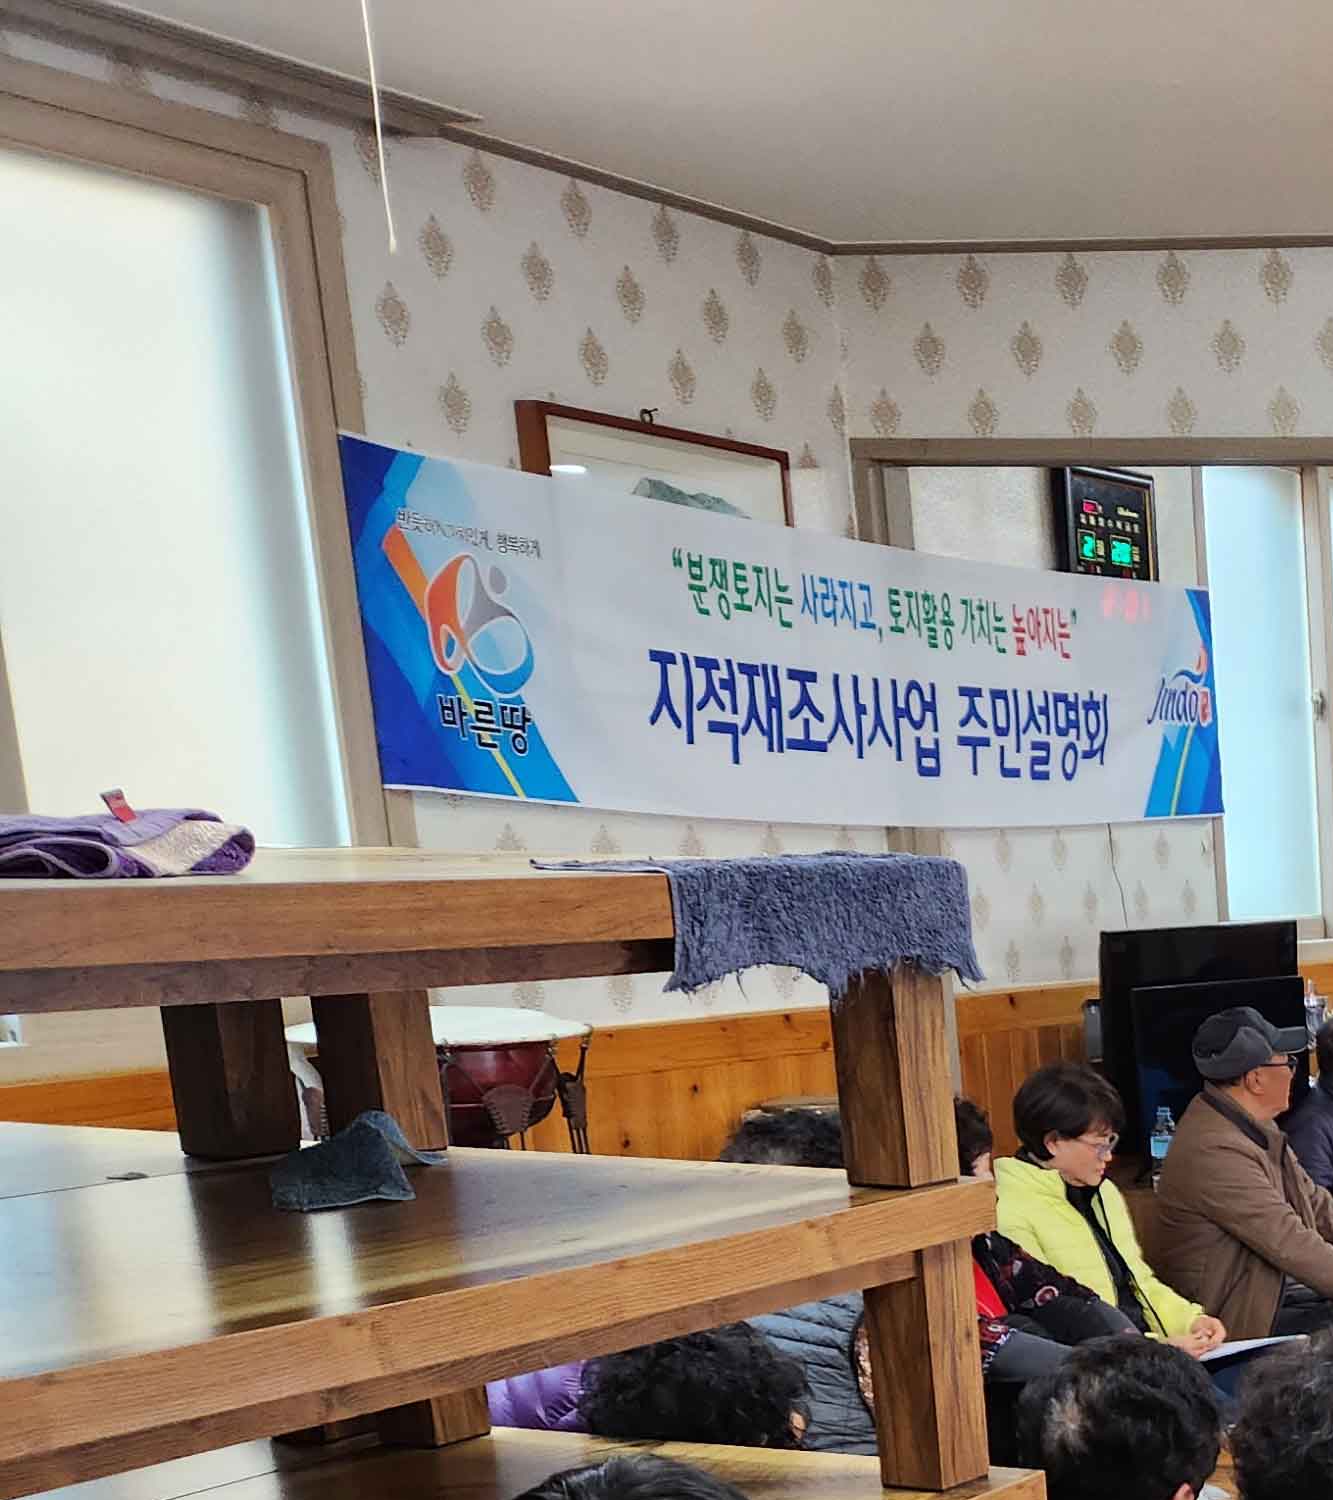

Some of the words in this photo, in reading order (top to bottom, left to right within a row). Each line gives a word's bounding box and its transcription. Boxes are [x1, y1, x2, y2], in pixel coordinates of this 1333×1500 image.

[800, 573, 884, 643] 사라지고,
[887, 587, 956, 650] 토지활용
[960, 598, 1007, 654] 가치는
[438, 694, 532, 755] 바른땅
[648, 649, 941, 778] 지적재조사사업
[956, 686, 1109, 781] 주민설명회
[1147, 677, 1198, 724] Jindo
